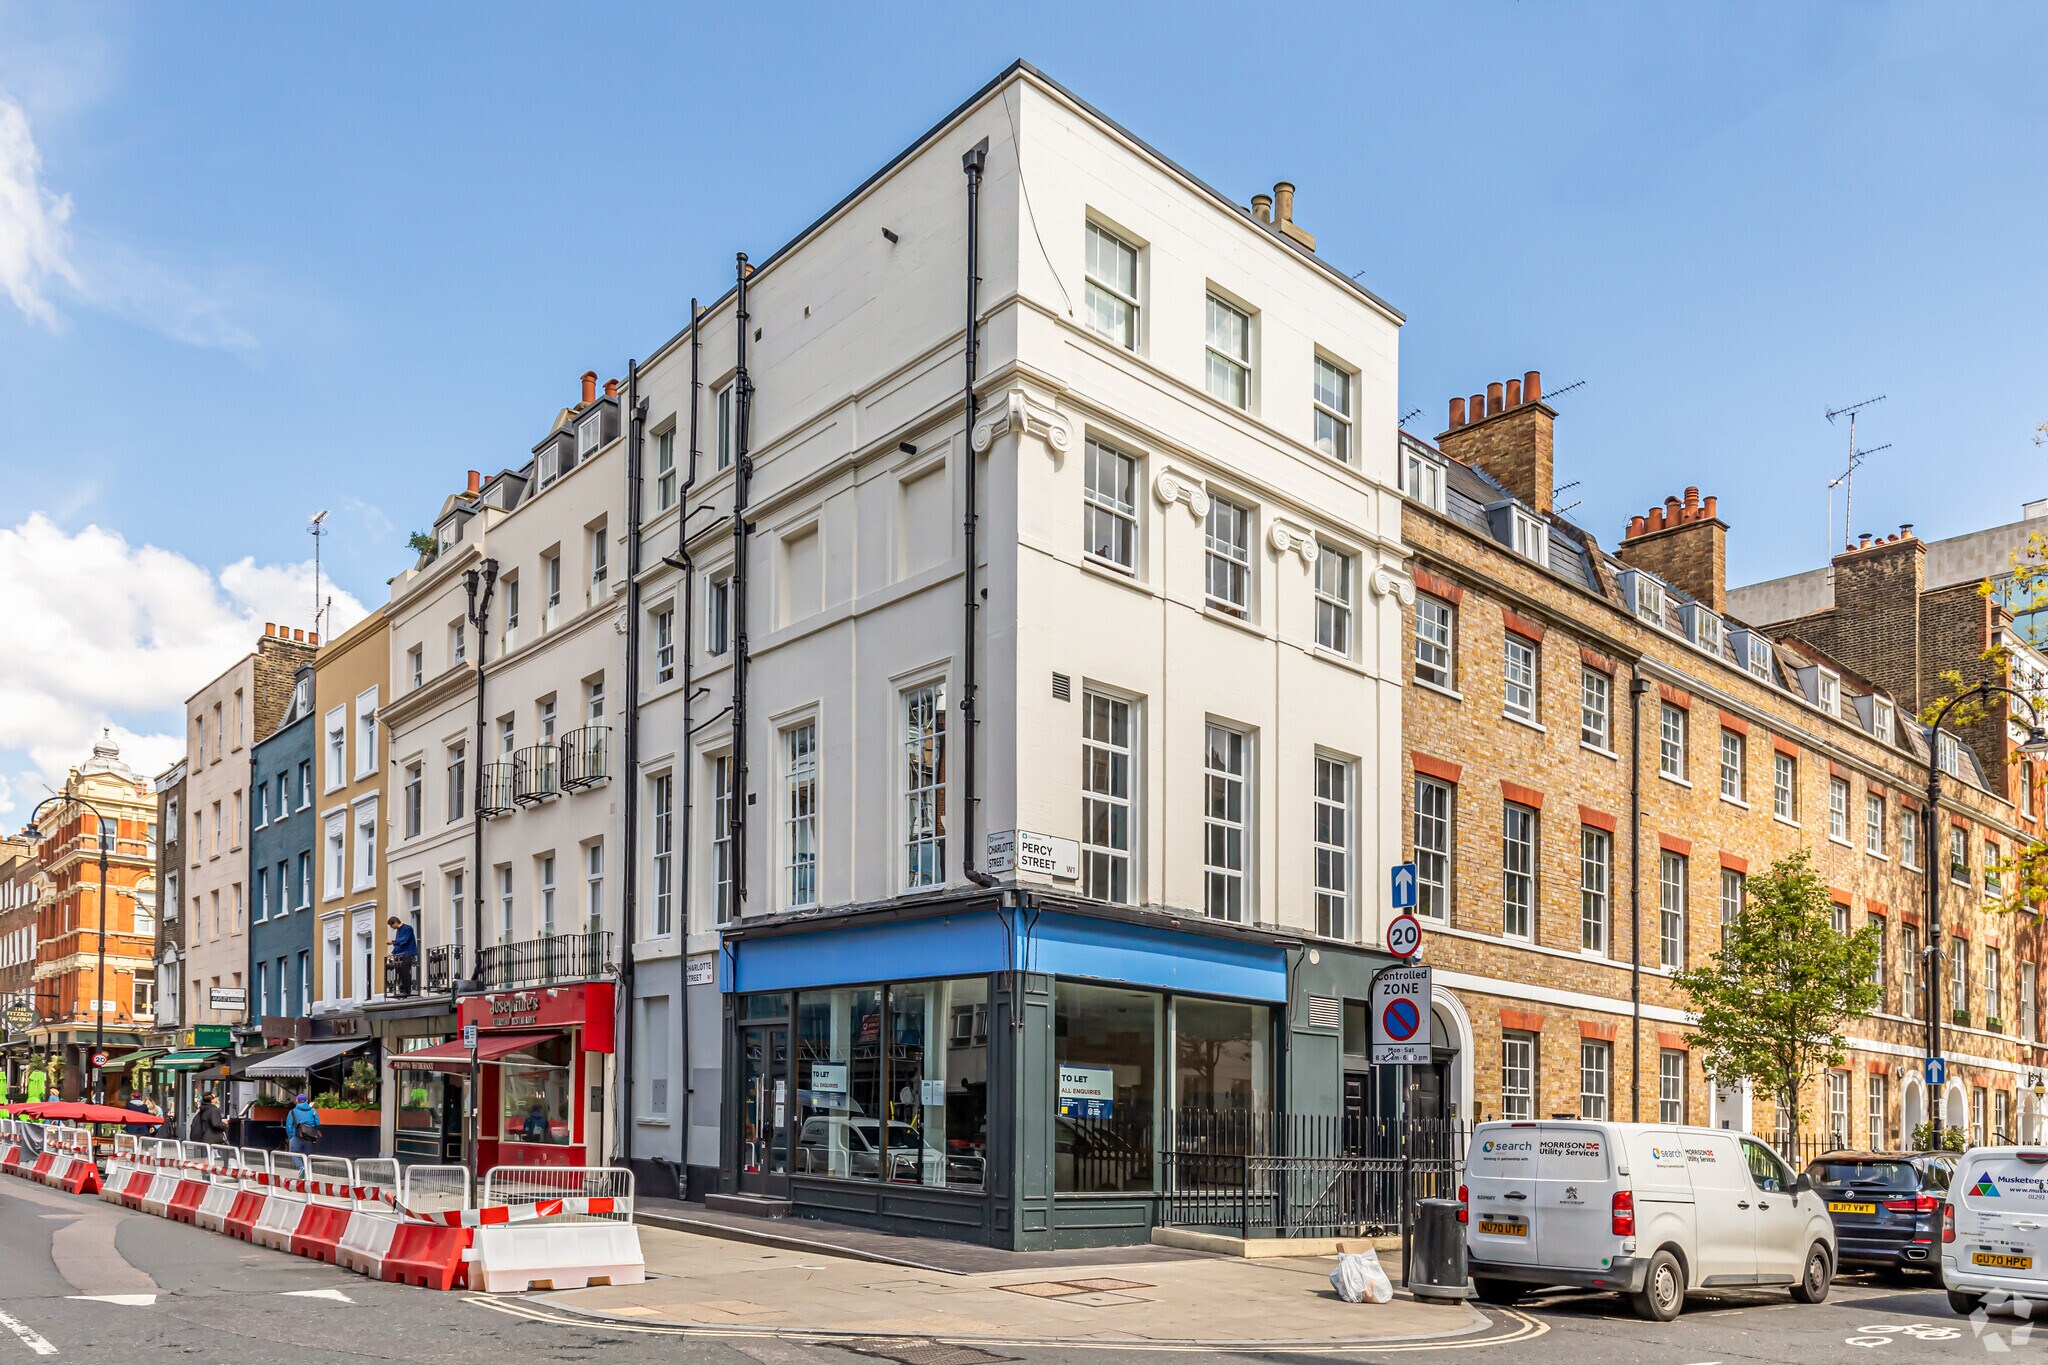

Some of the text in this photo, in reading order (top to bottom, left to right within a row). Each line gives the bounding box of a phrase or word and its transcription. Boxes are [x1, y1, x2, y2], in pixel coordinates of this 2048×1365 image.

[989, 841, 1014, 855] CHARLOTTE
[1022, 842, 1053, 856] PERCY
[989, 857, 1004, 868] STREET
[1022, 856, 1076, 874] STREET W1
[1392, 926, 1416, 946] 20
[1377, 970, 1427, 981] Controlled
[1383, 982, 1420, 995] ZONE
[1061, 1074, 1072, 1082] TO
[1496, 1141, 1532, 1151] search
[1540, 1148, 1600, 1158] Utility Services
[1660, 1149, 1682, 1158] search
[1686, 1155, 1699, 1163] Utility
[1998, 1176, 2044, 1185] Musketeer
[1482, 1223, 1522, 1234] NU70 UTF
[1976, 1254, 2028, 1267] GU70 HPC
